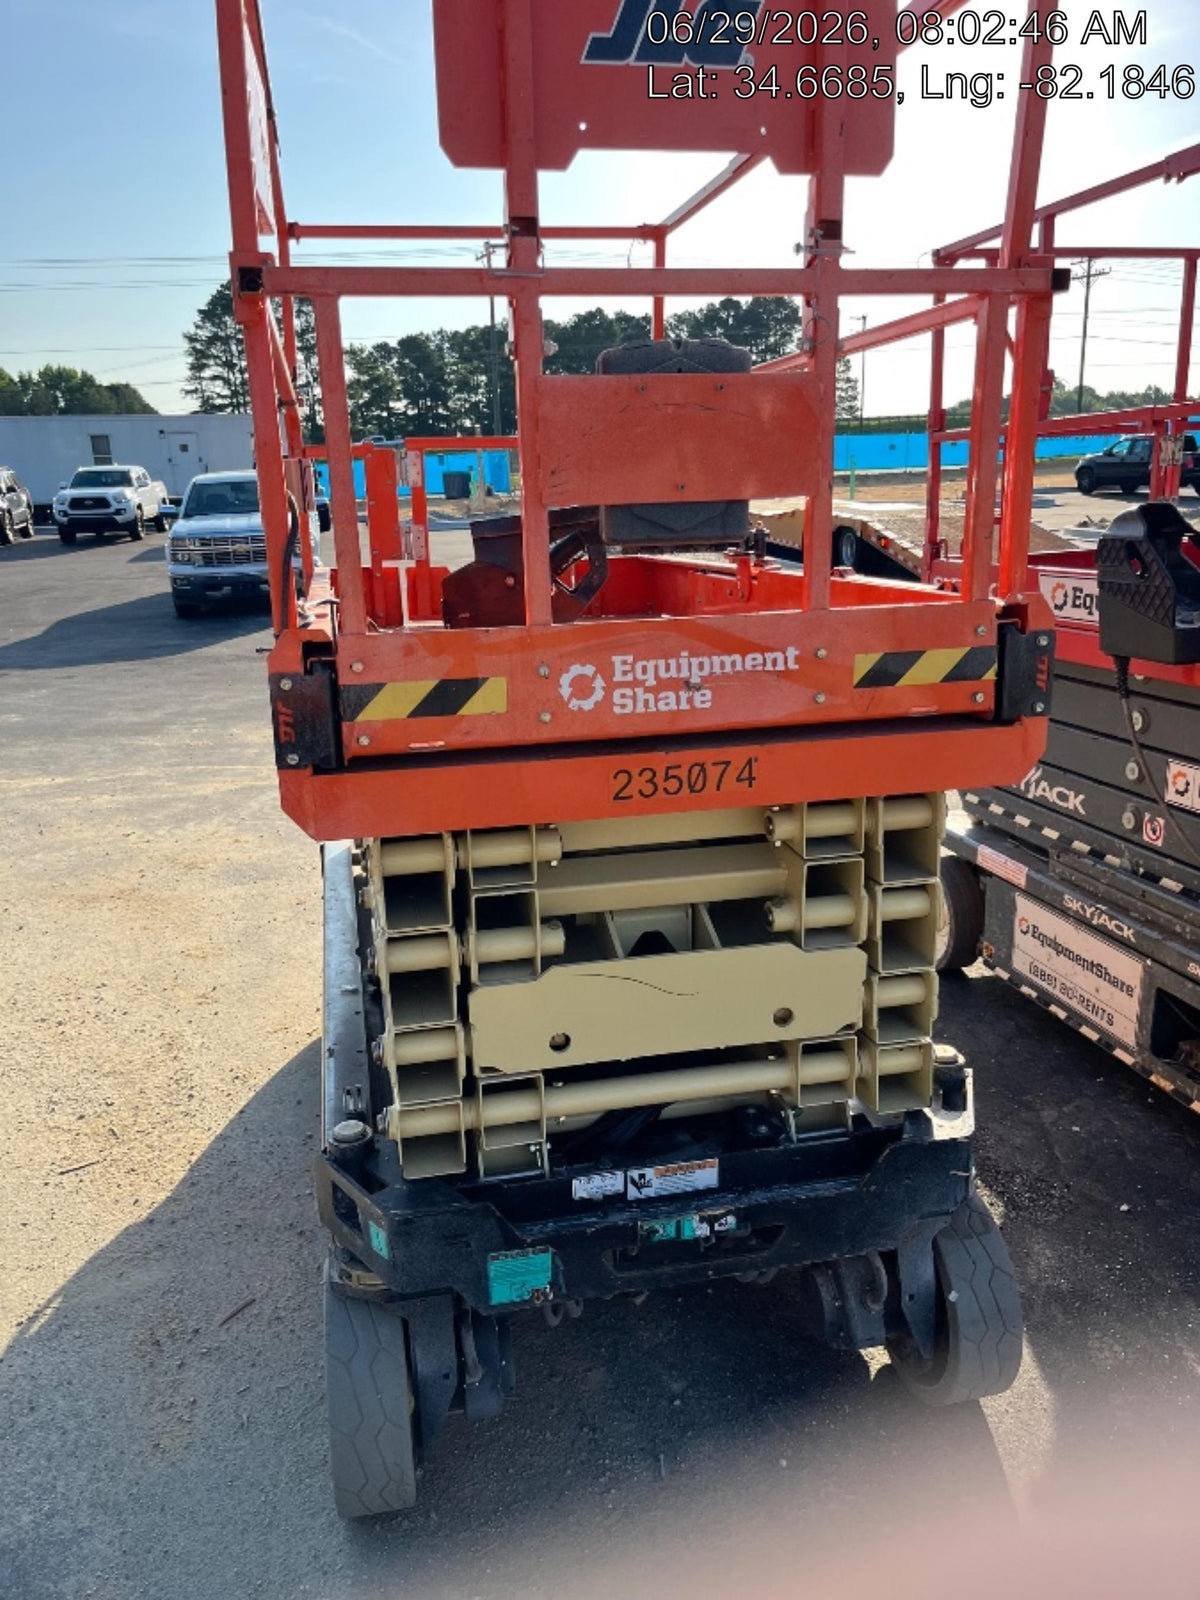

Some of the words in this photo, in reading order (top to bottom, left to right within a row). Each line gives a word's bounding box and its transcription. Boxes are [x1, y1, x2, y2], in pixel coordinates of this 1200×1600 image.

[611, 646, 800, 687] Equipment
[612, 686, 712, 715] Share
[612, 756, 758, 801] 235074
[1031, 924, 1134, 998] EquipmentShare
